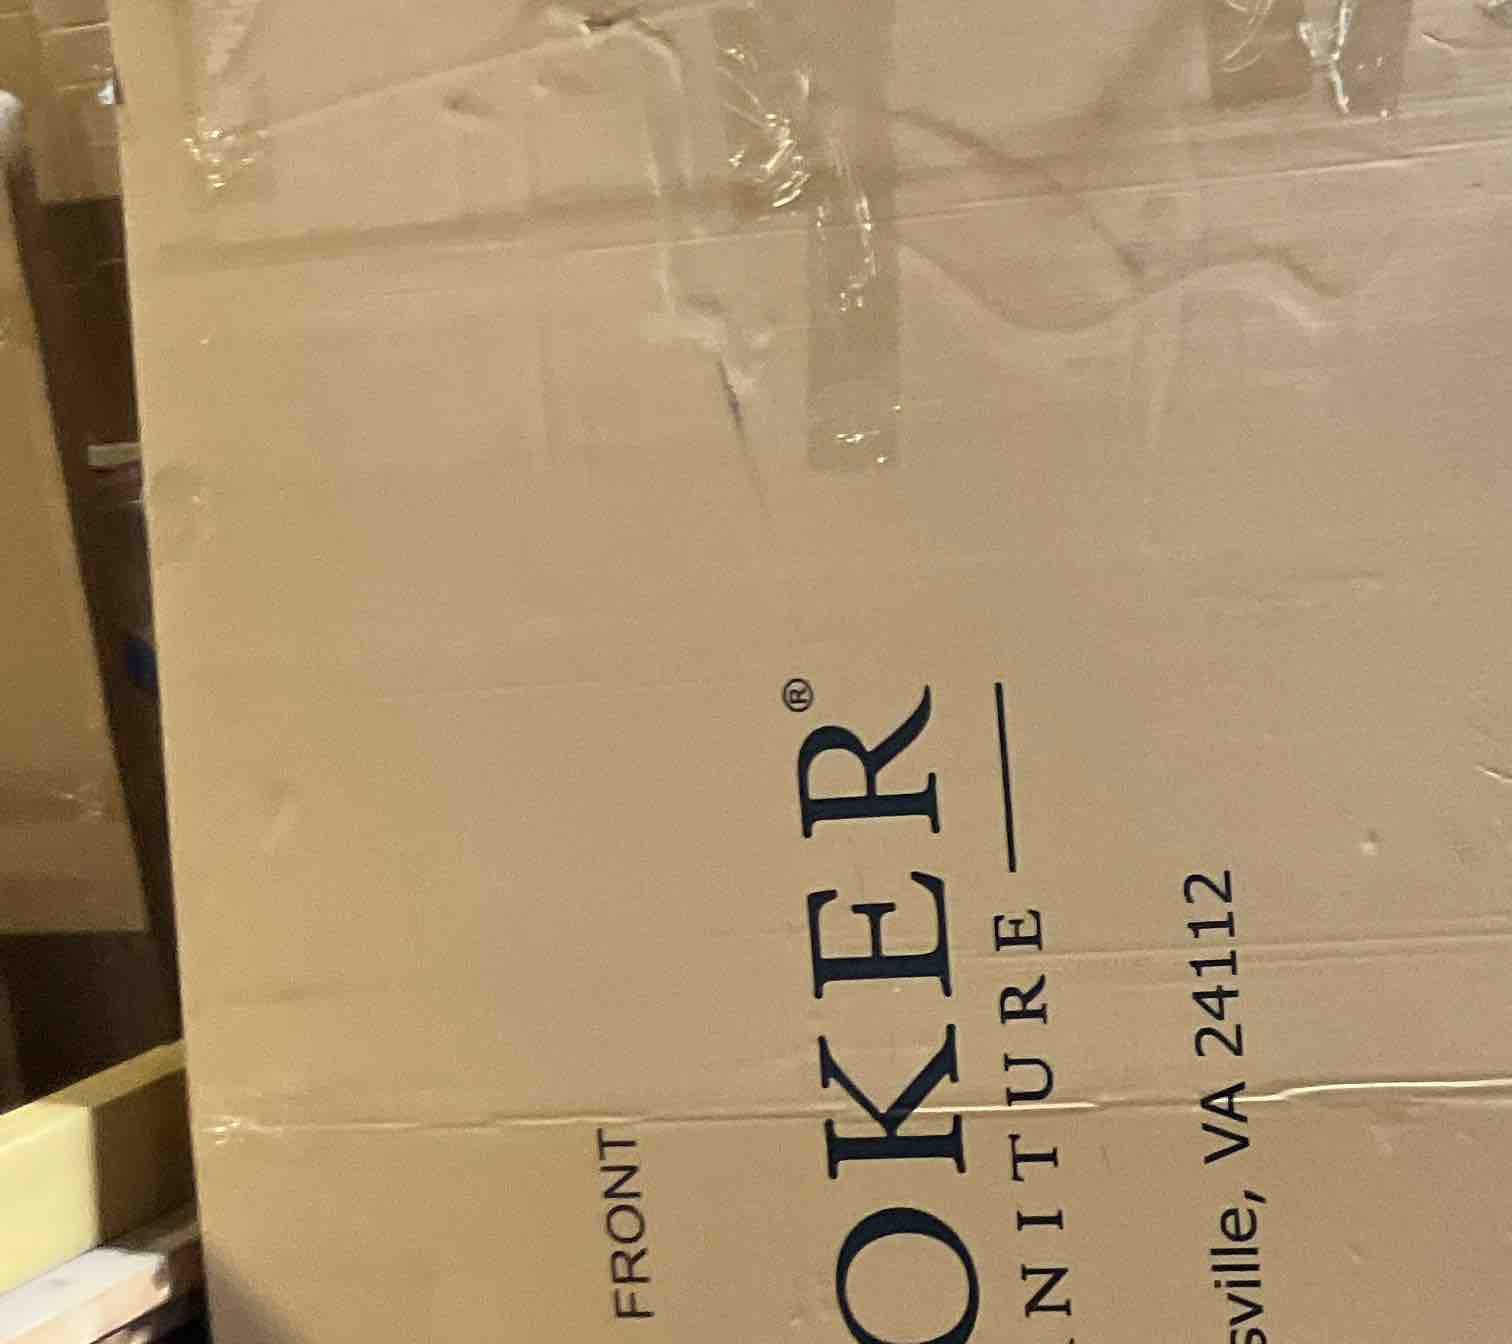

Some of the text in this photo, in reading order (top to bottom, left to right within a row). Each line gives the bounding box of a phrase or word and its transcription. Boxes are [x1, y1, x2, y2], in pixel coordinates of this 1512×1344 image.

[1183, 870, 1244, 1058] 24112
[1202, 1080, 1251, 1165] VA
[599, 1128, 655, 1323] FRONT
